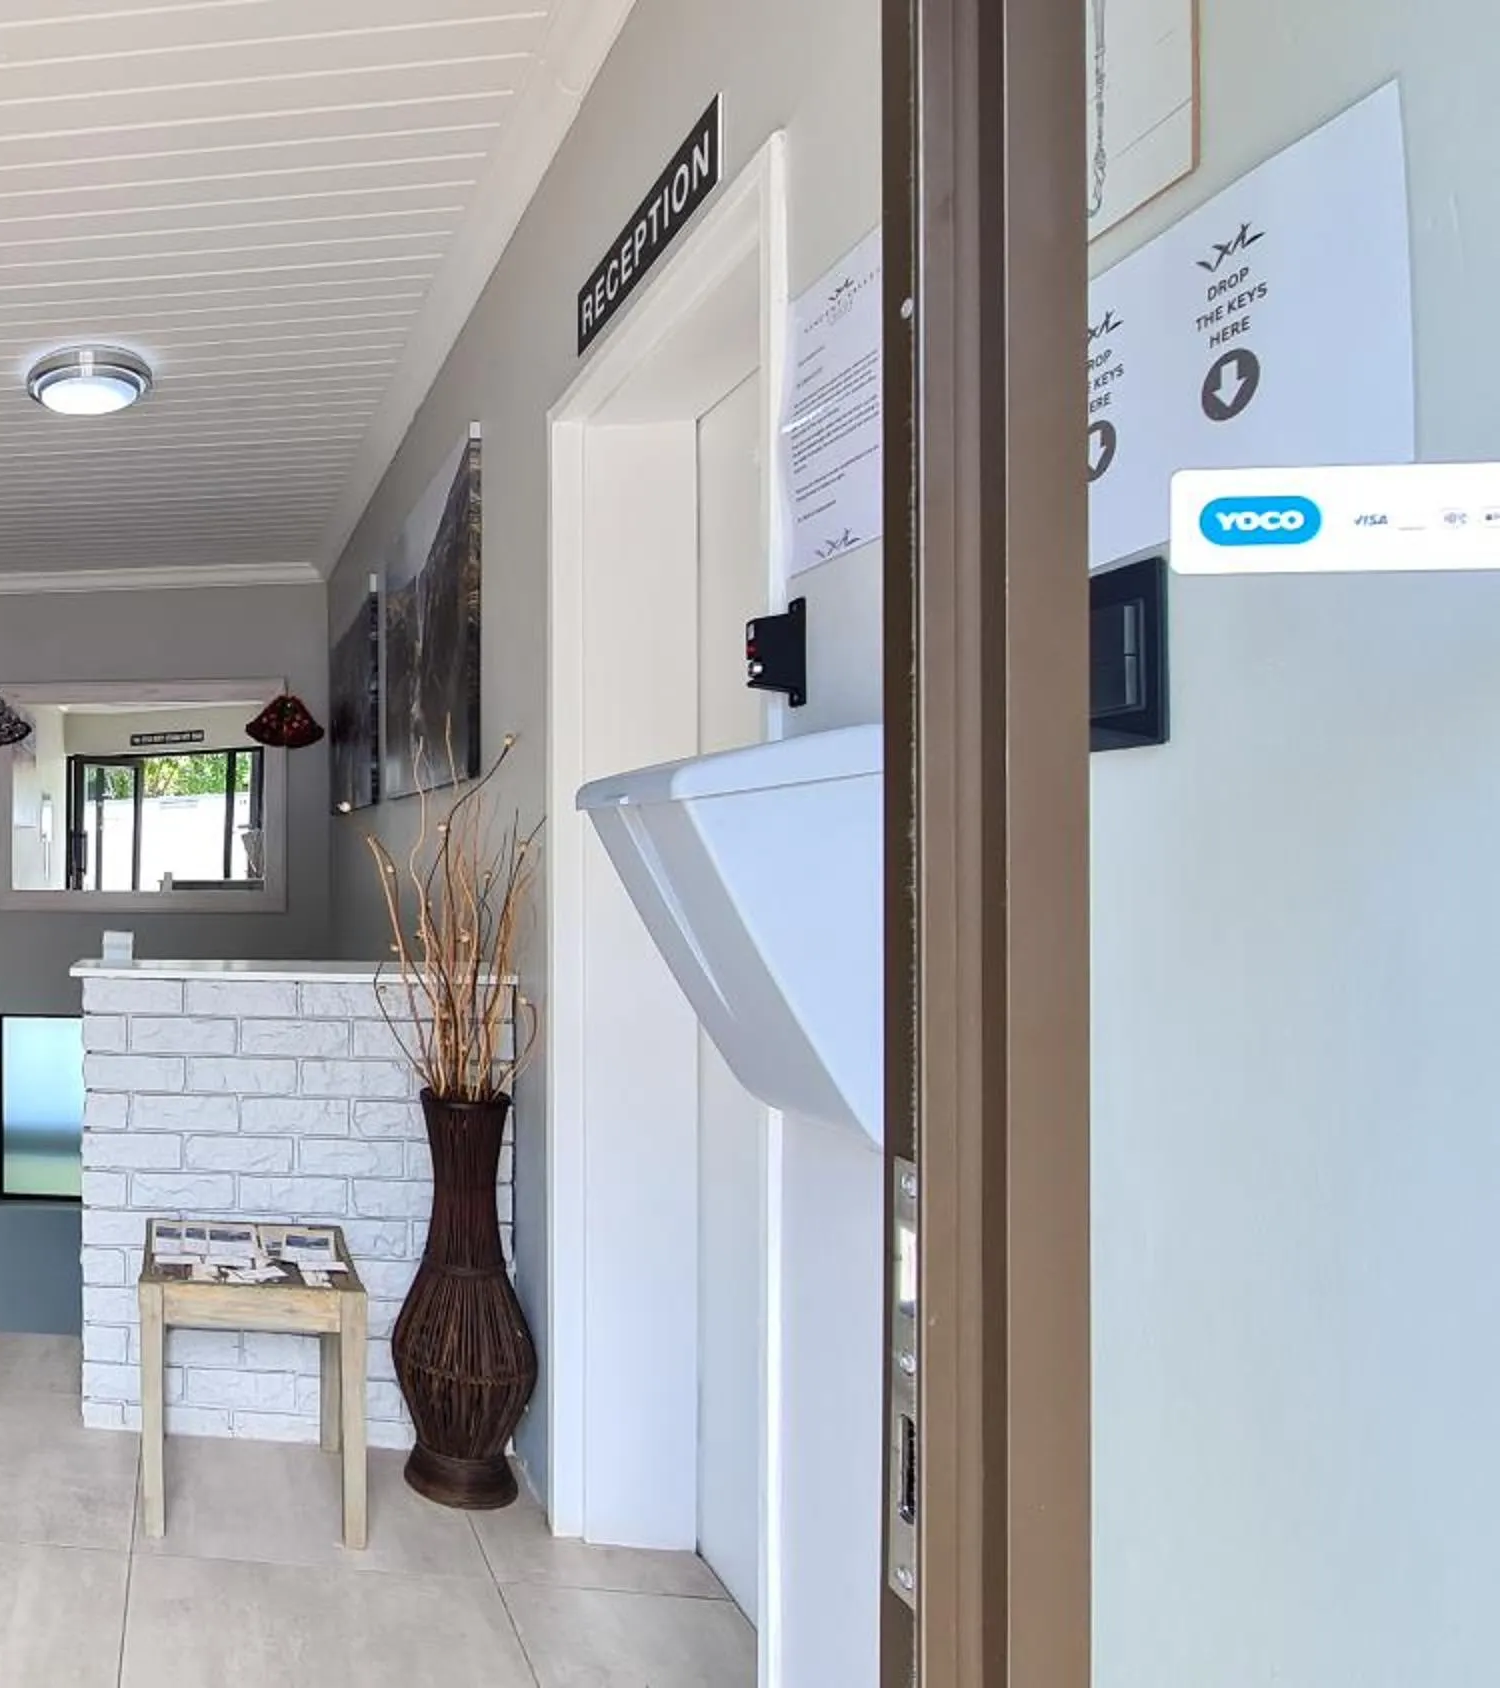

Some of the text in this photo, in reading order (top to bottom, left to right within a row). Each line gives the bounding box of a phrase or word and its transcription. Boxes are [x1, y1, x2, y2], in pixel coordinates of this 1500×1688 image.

[581, 129, 709, 336] RECEPTION
[1207, 267, 1250, 301] DROP
[1196, 282, 1267, 332] THE KEYS
[1209, 316, 1251, 348] HERE
[1089, 392, 1112, 413] ERE
[1215, 509, 1388, 531] YOCO VISA
